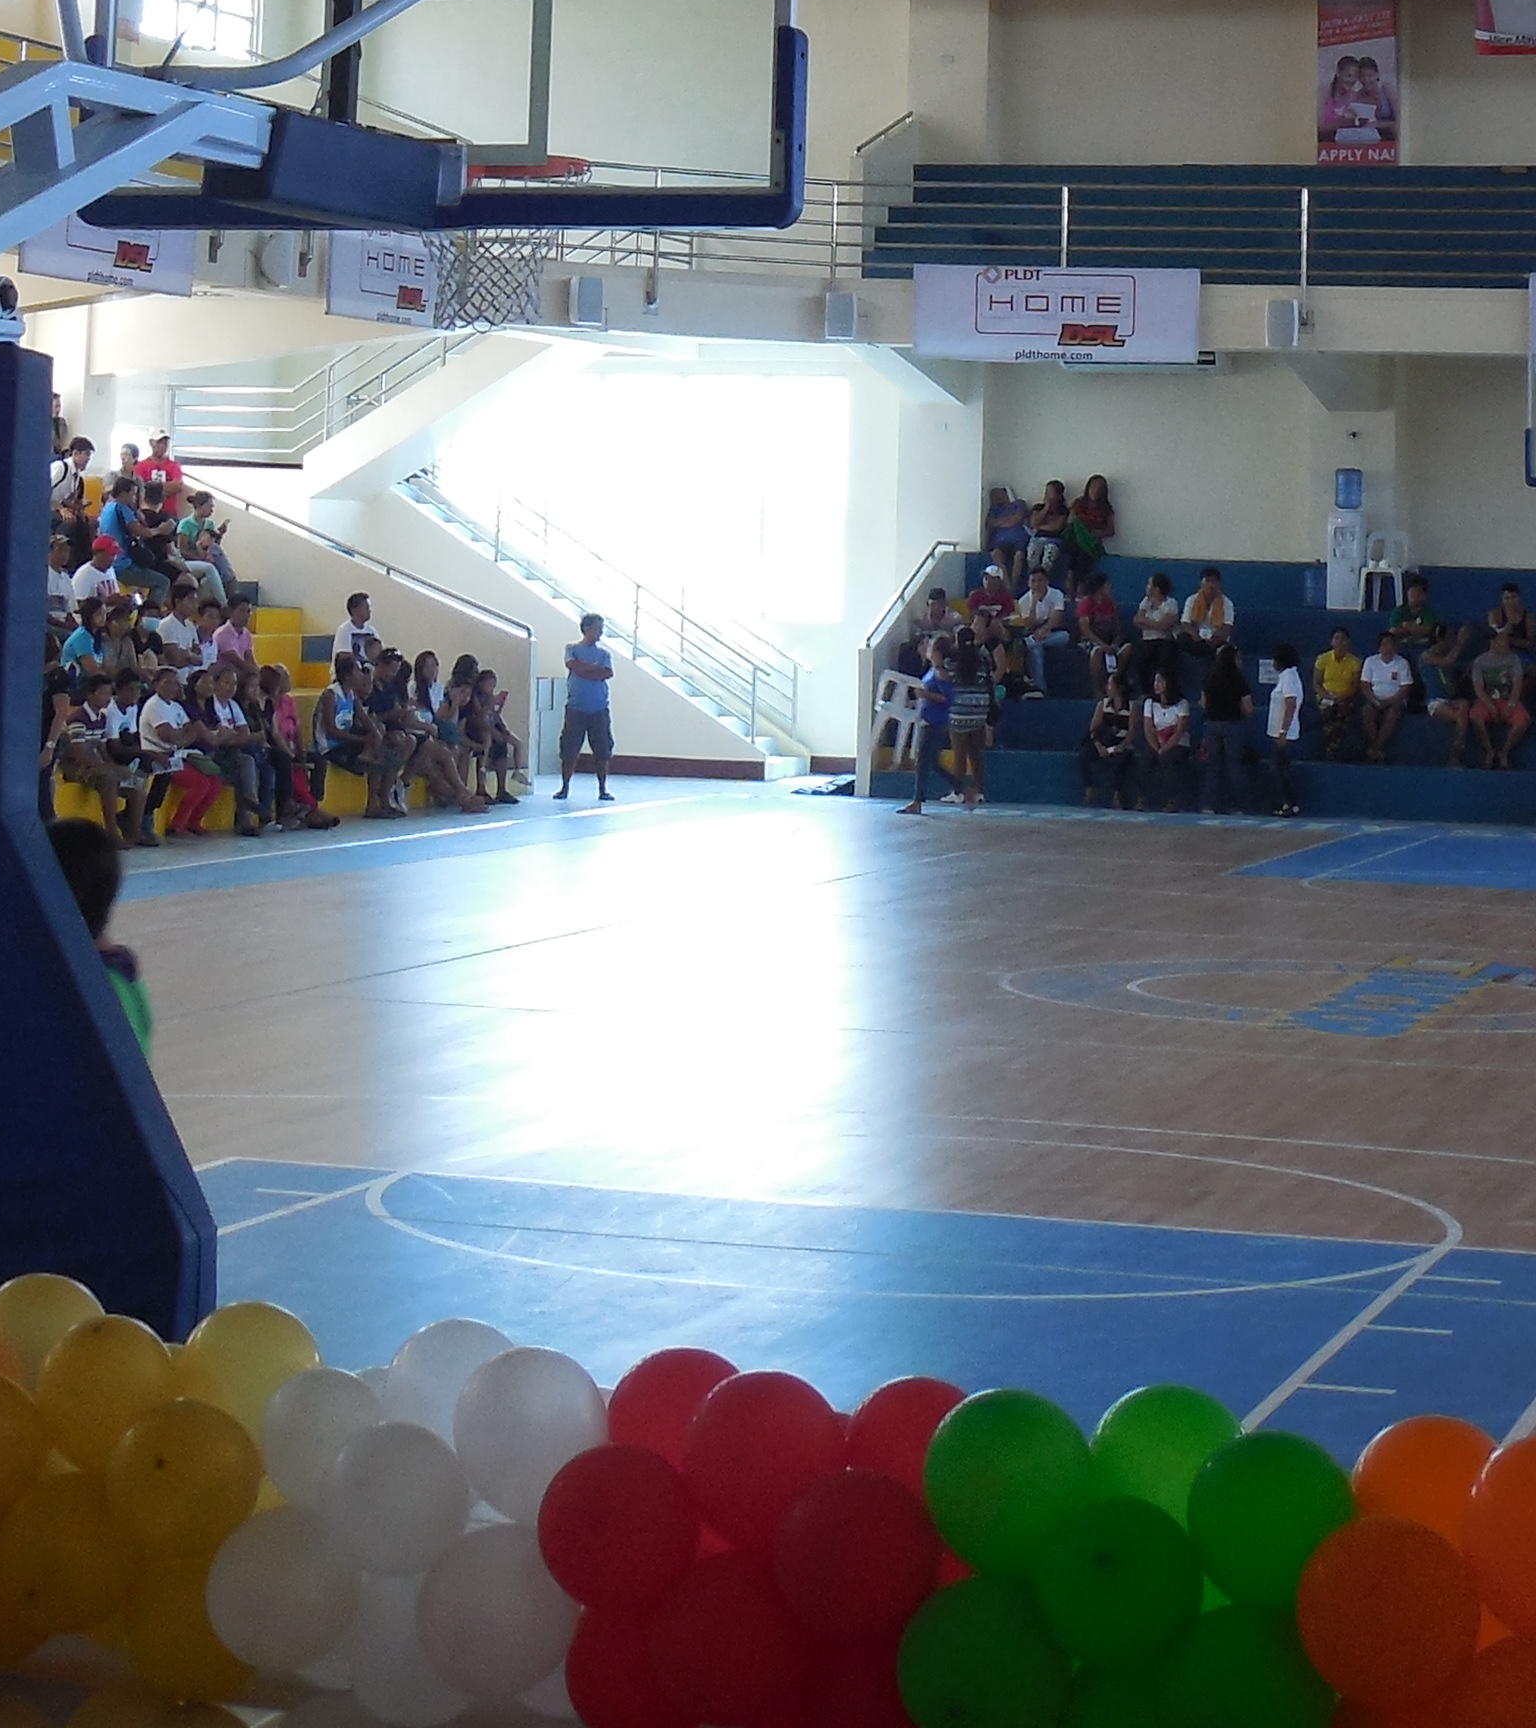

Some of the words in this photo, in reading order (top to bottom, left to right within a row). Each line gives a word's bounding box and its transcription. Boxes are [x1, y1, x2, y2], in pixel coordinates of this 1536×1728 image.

[1318, 148, 1363, 162] APPLY
[1369, 148, 1395, 161] NA!
[114, 240, 154, 273] DSL
[367, 250, 425, 277] HOME
[1004, 269, 1043, 282] PLDT
[989, 294, 1123, 314] HOME
[1058, 323, 1127, 348] DSL
[1014, 349, 1094, 362] pldthome.com
